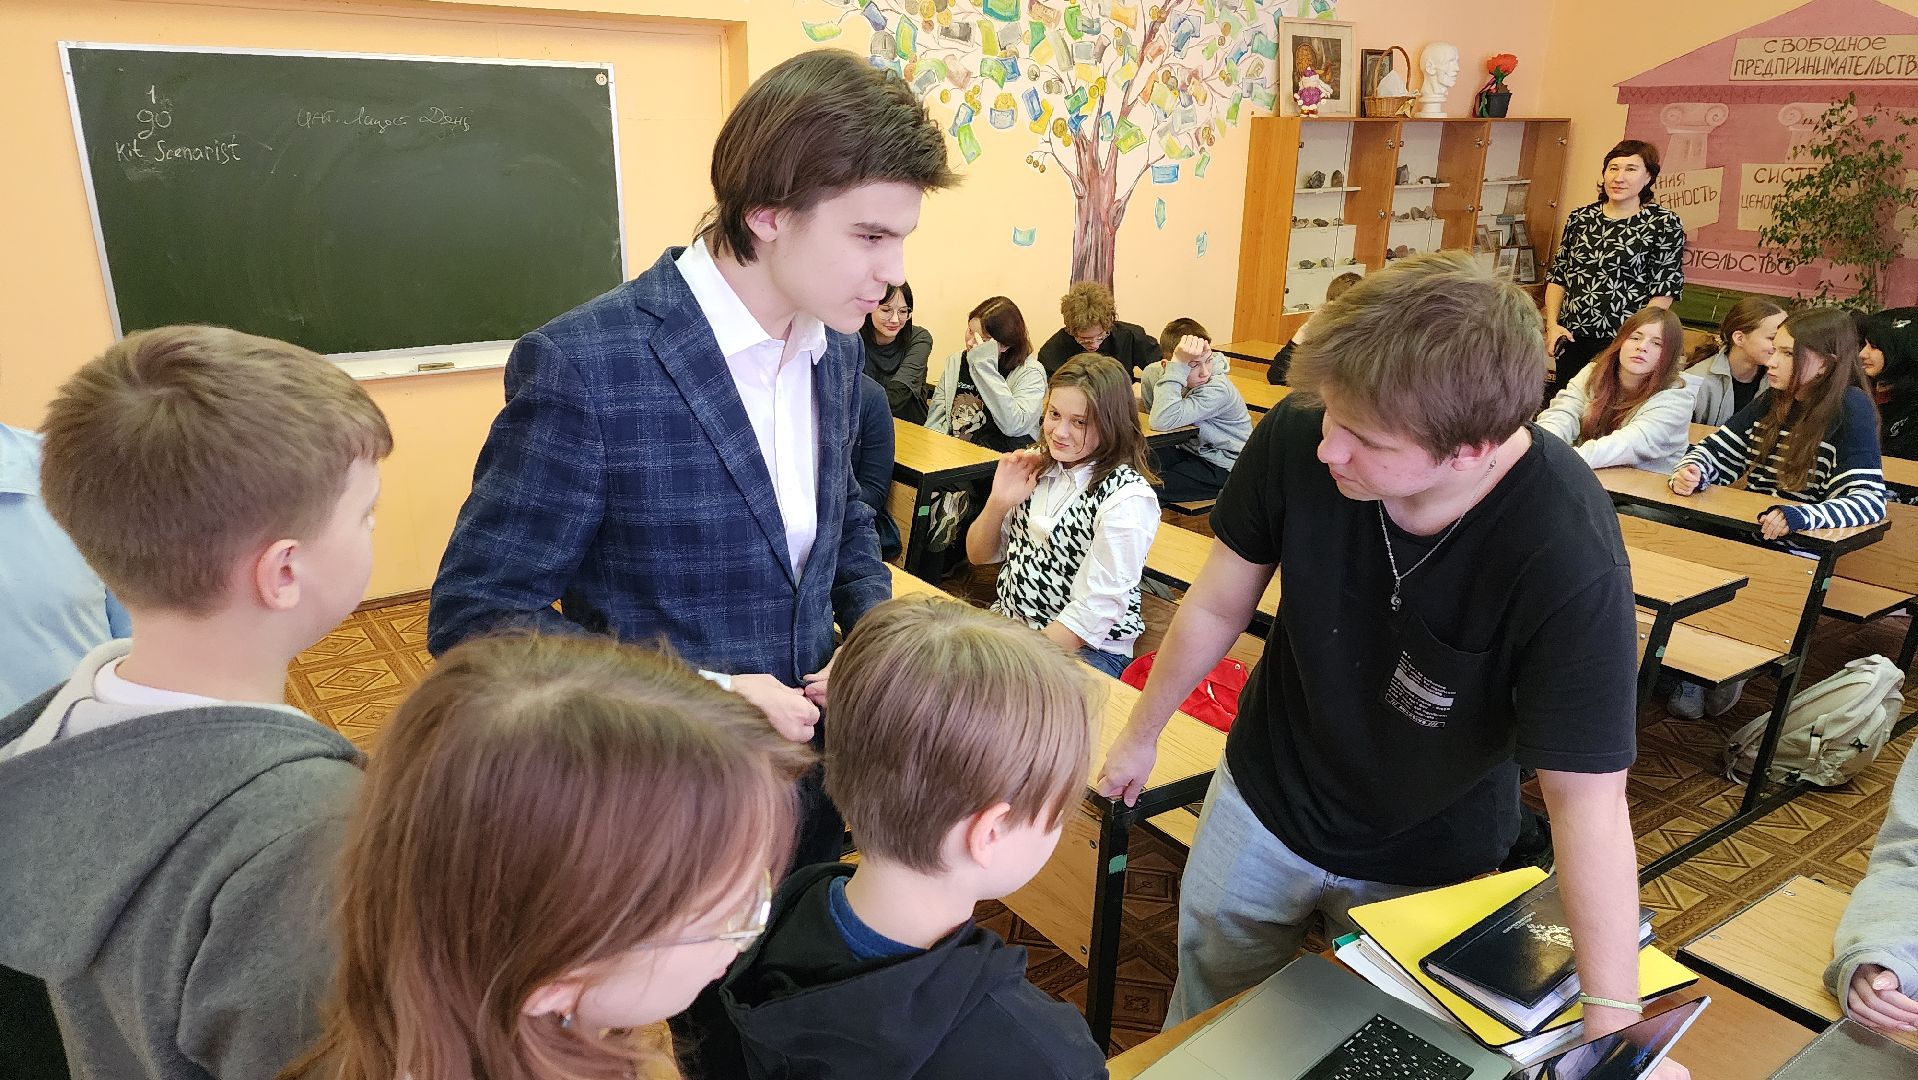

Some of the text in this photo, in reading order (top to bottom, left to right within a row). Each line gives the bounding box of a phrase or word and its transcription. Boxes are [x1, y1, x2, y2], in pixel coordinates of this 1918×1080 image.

[1764, 36, 1887, 54] СВОБОДНОЕ
[1734, 54, 1918, 78] ПРЕДПРИНИМАТЕЛЬСТВ
[1659, 185, 1718, 210] ЕННОСТЬ
[1682, 248, 1796, 276] ательство
